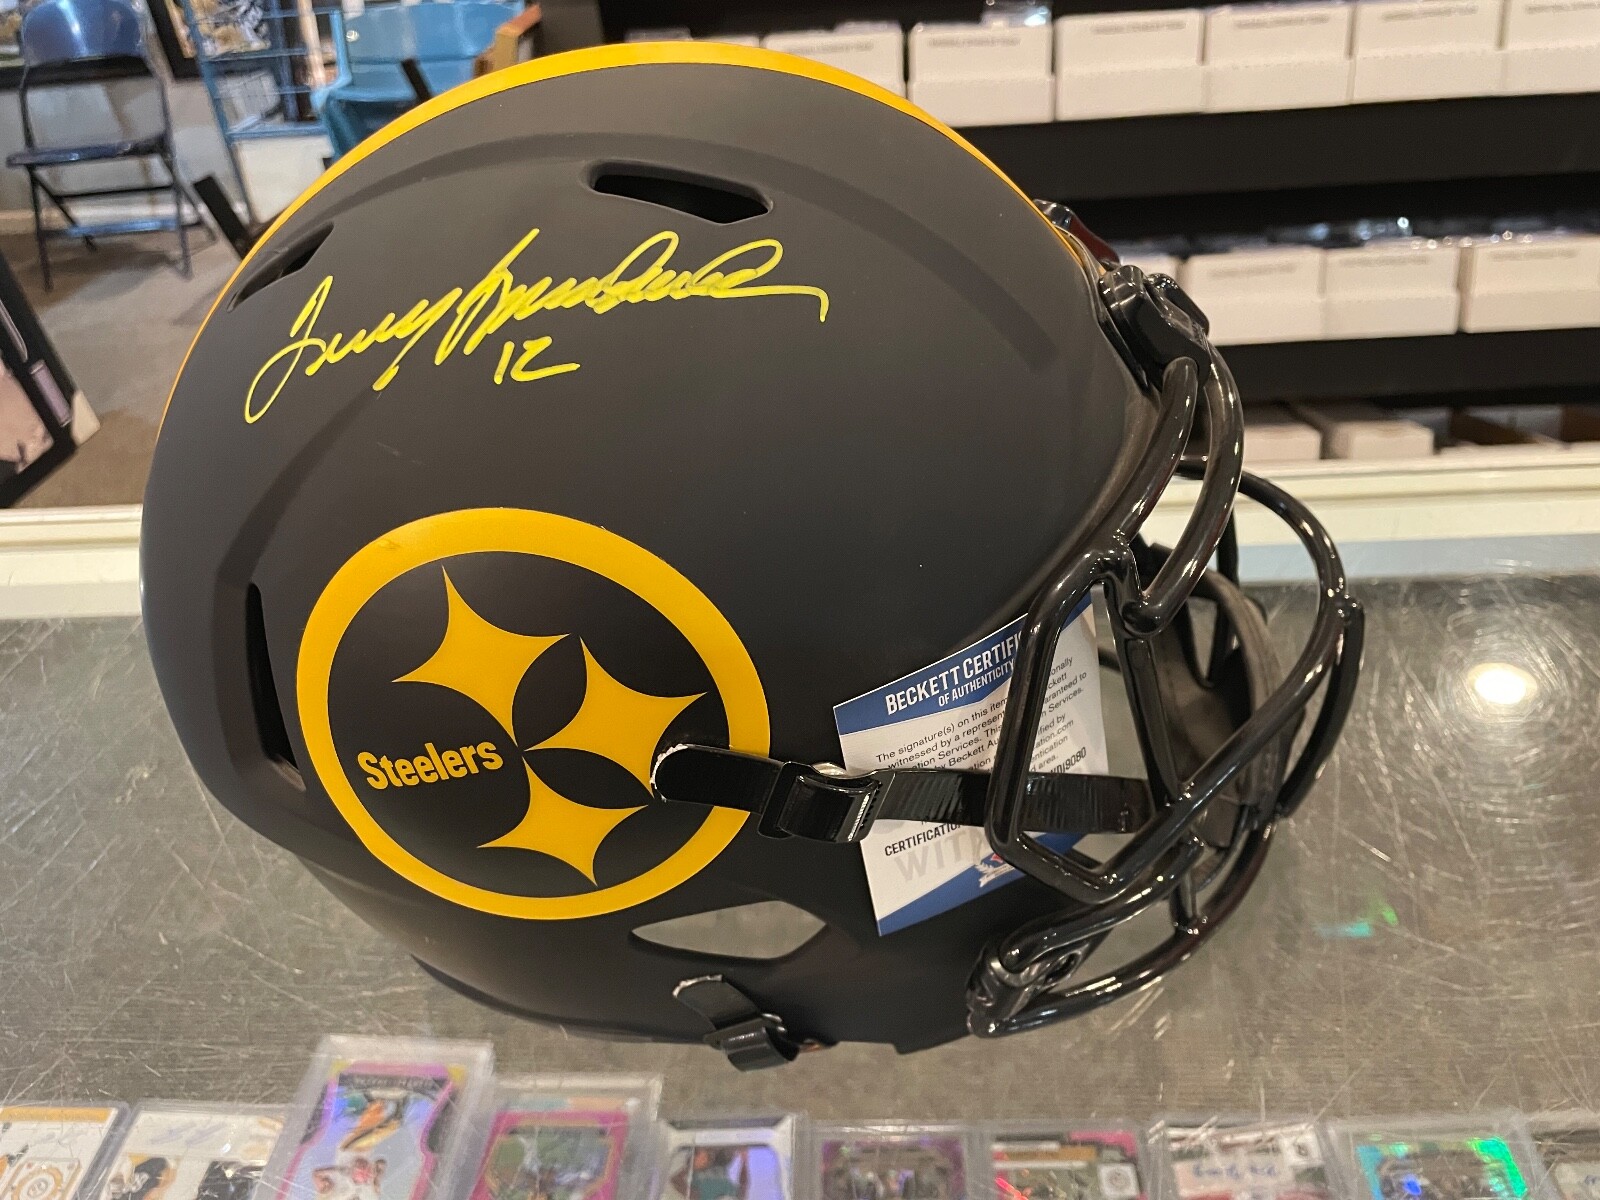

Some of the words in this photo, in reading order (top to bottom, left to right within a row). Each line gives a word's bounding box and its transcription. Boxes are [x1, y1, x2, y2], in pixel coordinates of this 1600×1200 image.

[494, 336, 581, 384] 12
[885, 666, 961, 715] BECKETT
[938, 693, 950, 707] OF
[952, 658, 1014, 701] AUTHENTICITY
[876, 751, 896, 763] The
[898, 723, 955, 754] signature(s)
[957, 718, 970, 728] on
[971, 708, 988, 721] this
[1050, 657, 1073, 676] onally
[888, 743, 938, 769] witnessed
[941, 737, 952, 749] by
[962, 710, 1006, 737] represent
[1048, 672, 1067, 689] ckett
[938, 736, 982, 760] Services.
[1044, 676, 1078, 704] aranteed
[1079, 672, 1088, 681] to
[1056, 713, 1066, 724] by
[357, 741, 504, 789] Steelers
[949, 745, 985, 767] Beckett
[884, 823, 960, 857] CERTIFICATIO
